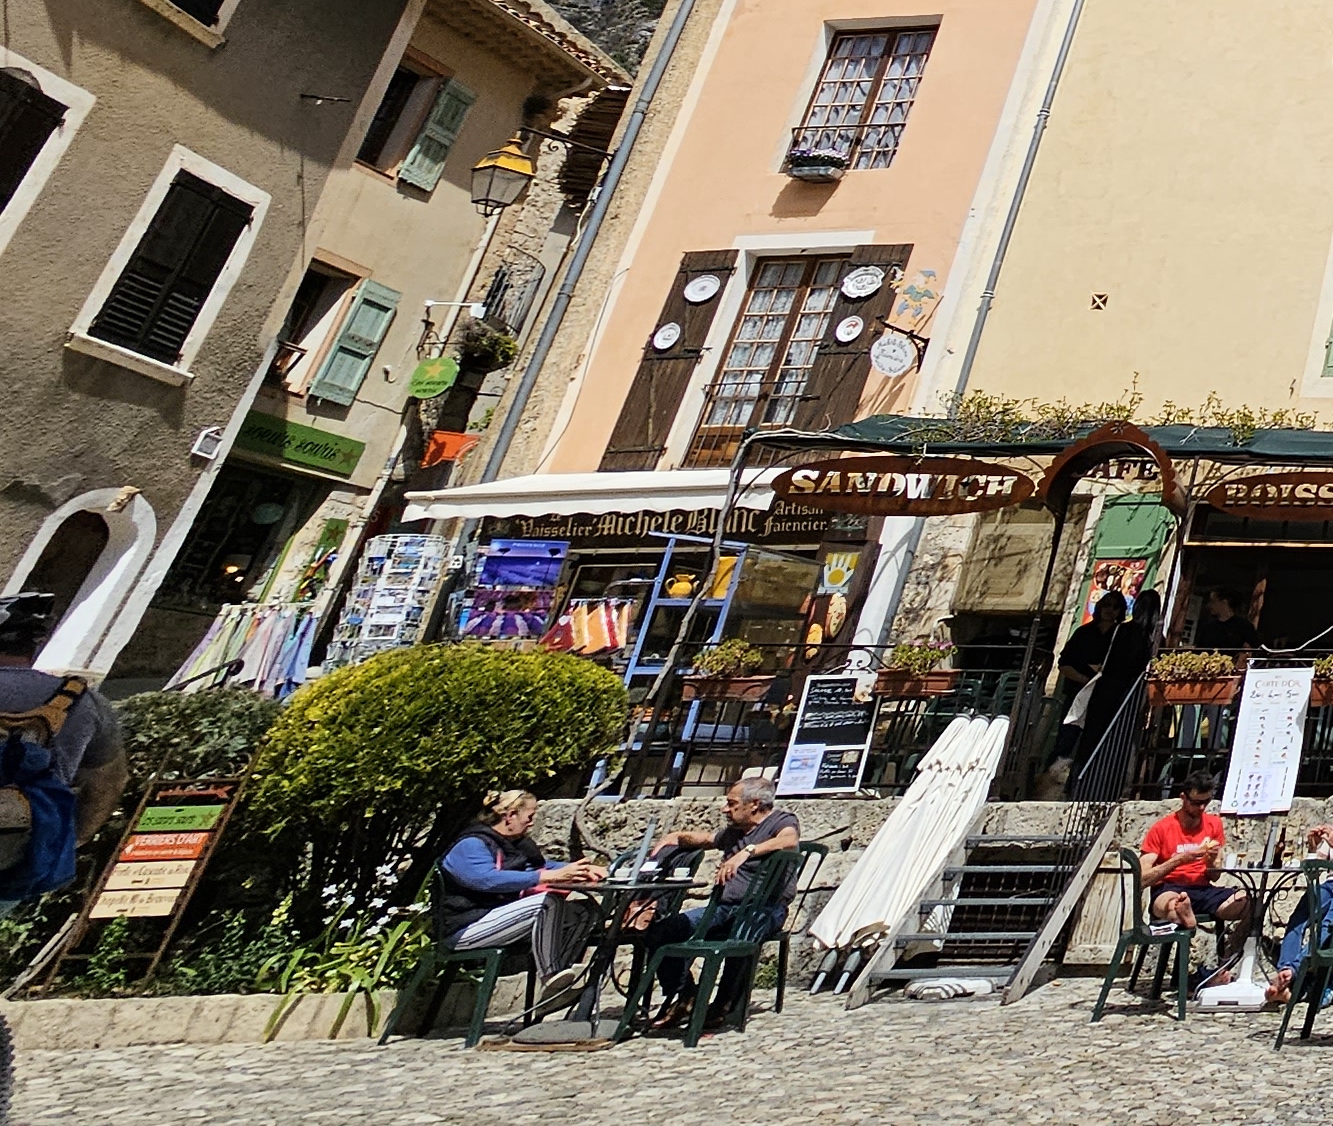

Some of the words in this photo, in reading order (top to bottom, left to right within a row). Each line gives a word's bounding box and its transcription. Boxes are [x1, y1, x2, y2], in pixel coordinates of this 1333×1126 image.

[1087, 460, 1162, 480] AFE
[787, 468, 1019, 502] SANDWICH
[774, 500, 824, 516] Artisan
